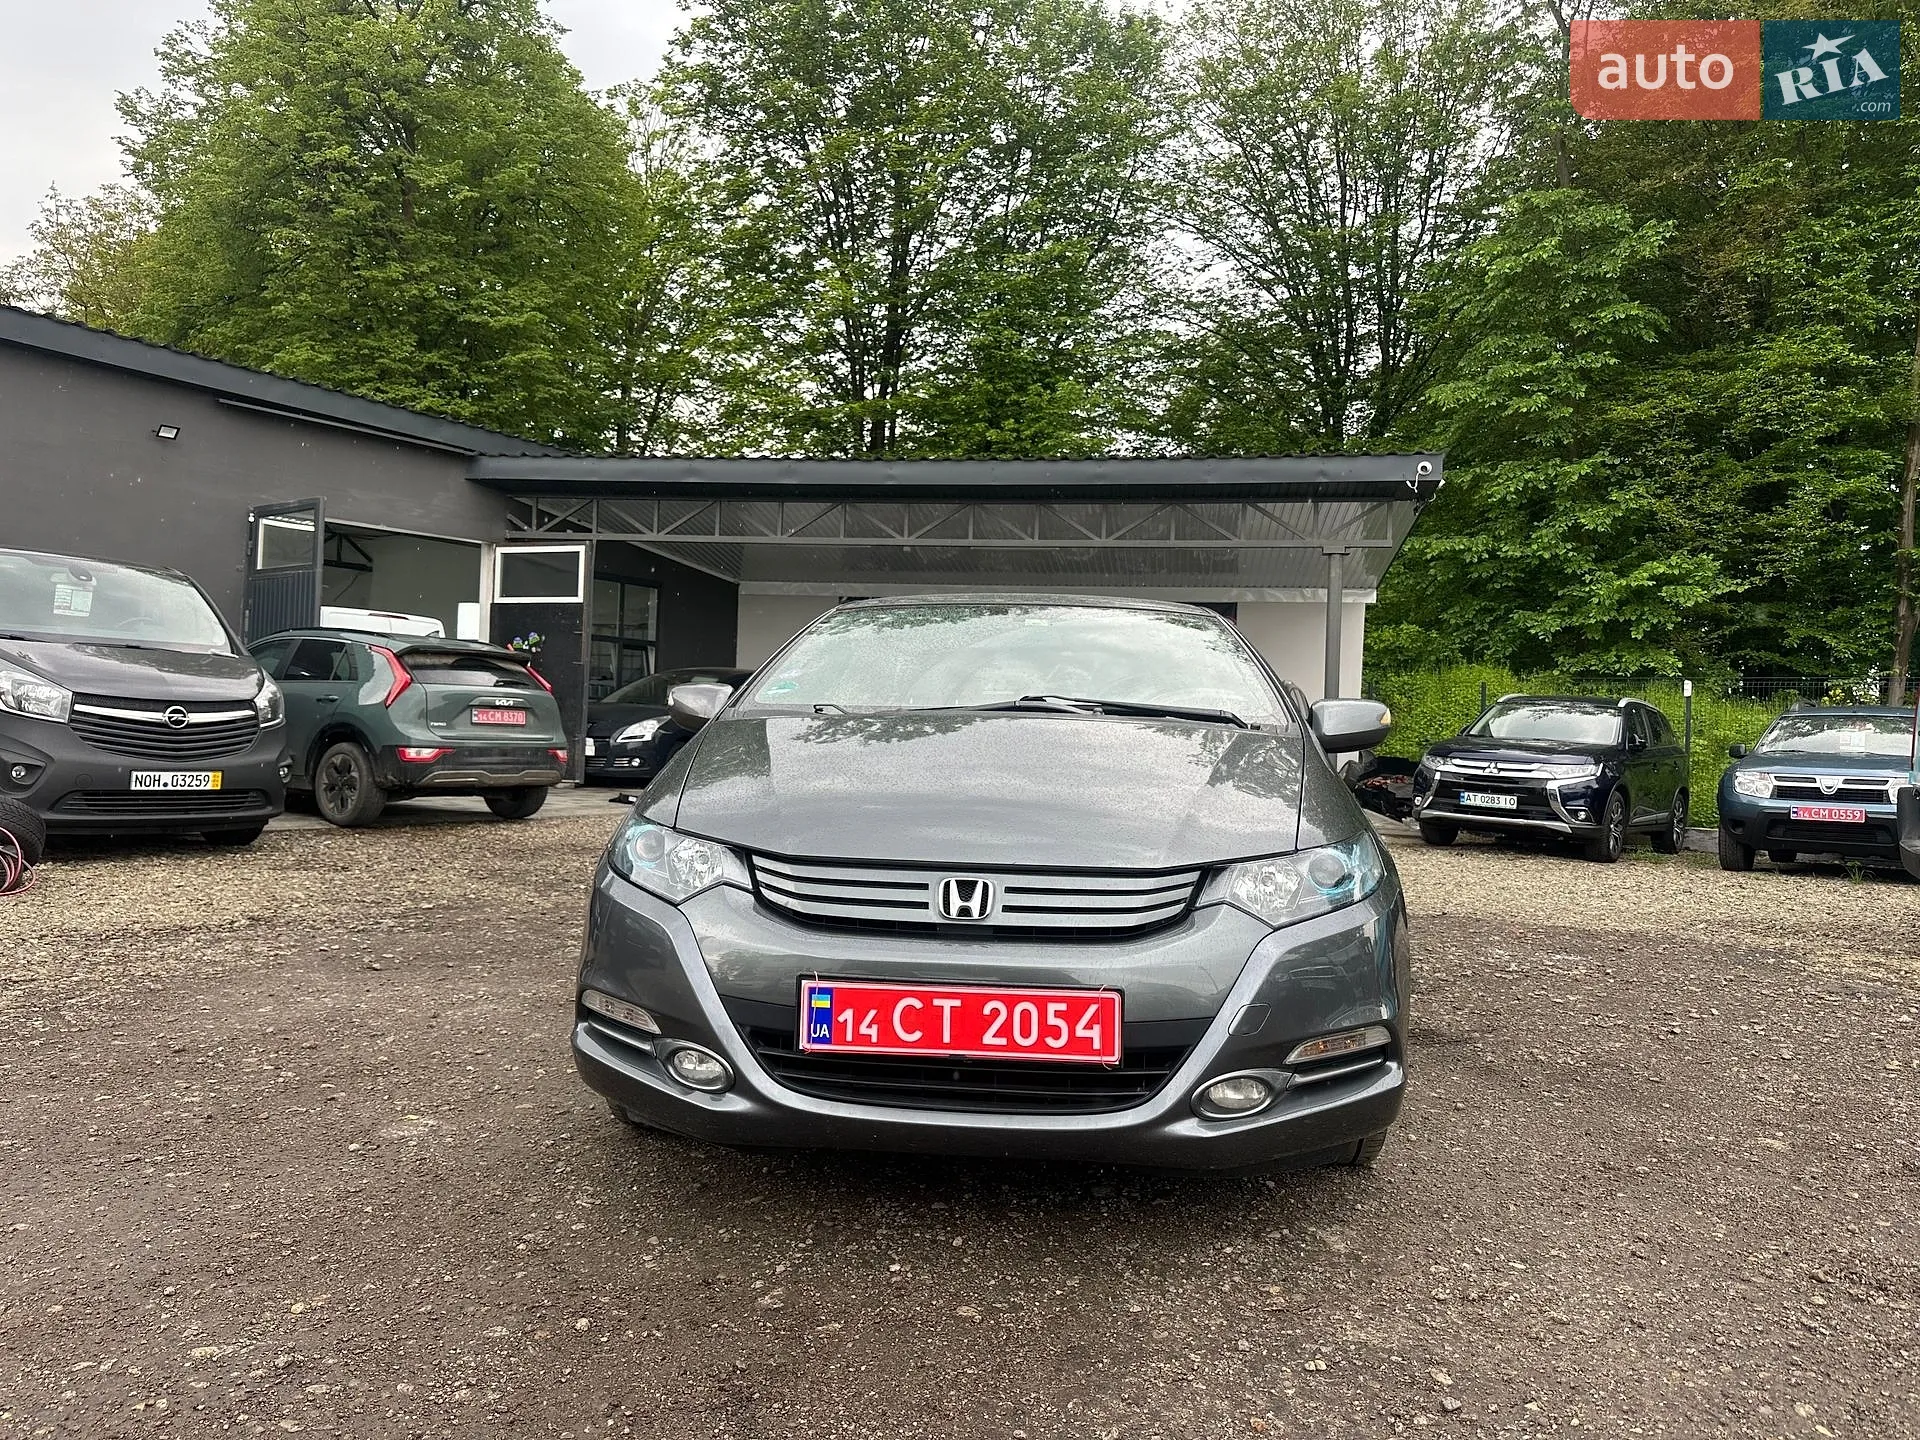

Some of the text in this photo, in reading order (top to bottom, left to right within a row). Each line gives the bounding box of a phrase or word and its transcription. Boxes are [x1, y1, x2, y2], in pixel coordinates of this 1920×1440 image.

[488, 711, 502, 720] CM
[503, 712, 523, 722] 8370
[134, 774, 162, 788] NOH
[171, 774, 210, 788] 03259
[1465, 793, 1479, 803] AT
[1480, 795, 1501, 805] 0283
[1811, 808, 1829, 819] CM
[1832, 809, 1861, 820] 0559
[837, 997, 1101, 1050] 14 CT 2054
[810, 1023, 830, 1038] UA
